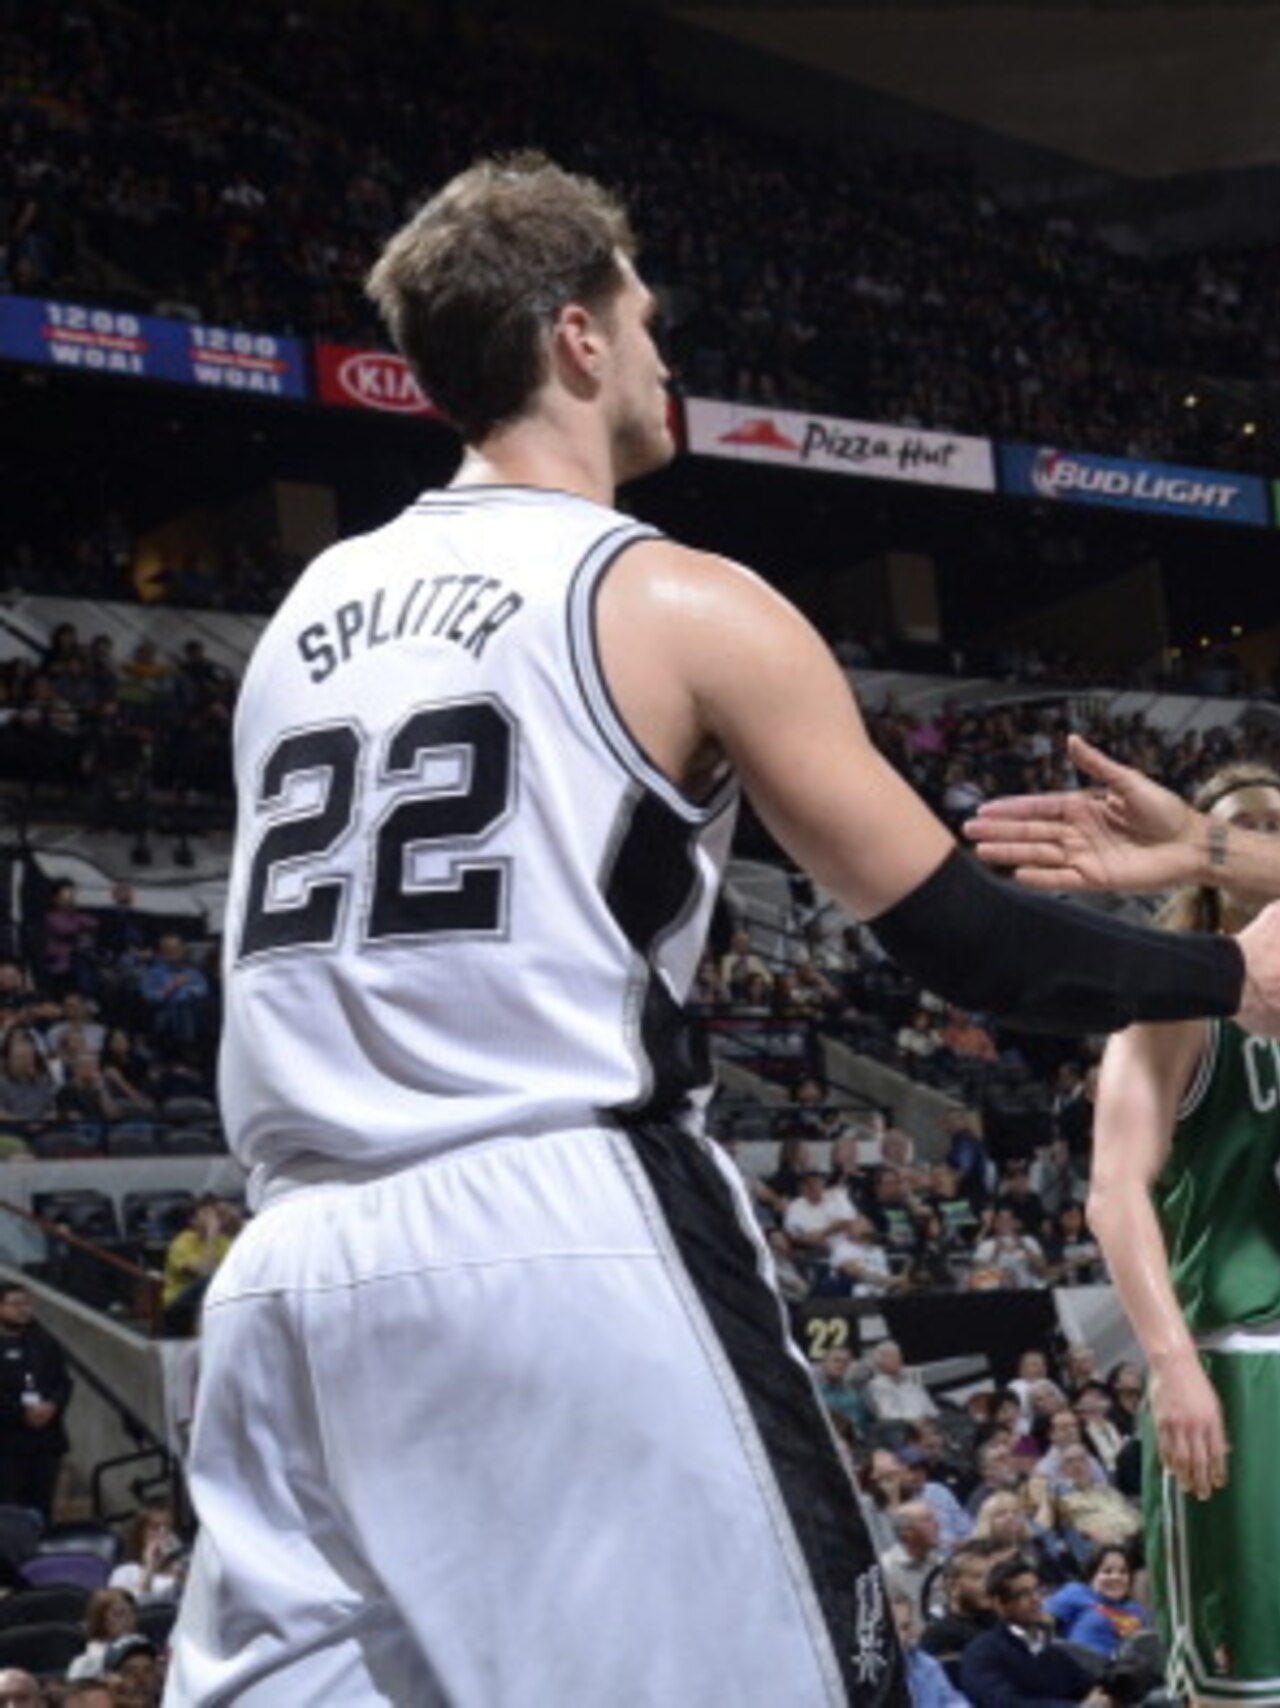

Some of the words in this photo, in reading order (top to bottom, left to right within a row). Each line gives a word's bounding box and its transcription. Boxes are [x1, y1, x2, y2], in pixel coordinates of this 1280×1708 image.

[46, 302, 140, 337] 1200
[50, 342, 144, 373] WOAI
[190, 326, 278, 358] 1200
[193, 362, 281, 394] WOAI
[357, 363, 424, 402] KIA
[800, 421, 889, 464] Pizza
[898, 435, 958, 471] Hut
[296, 573, 524, 684] SPLITTER
[235, 690, 521, 968] 22
